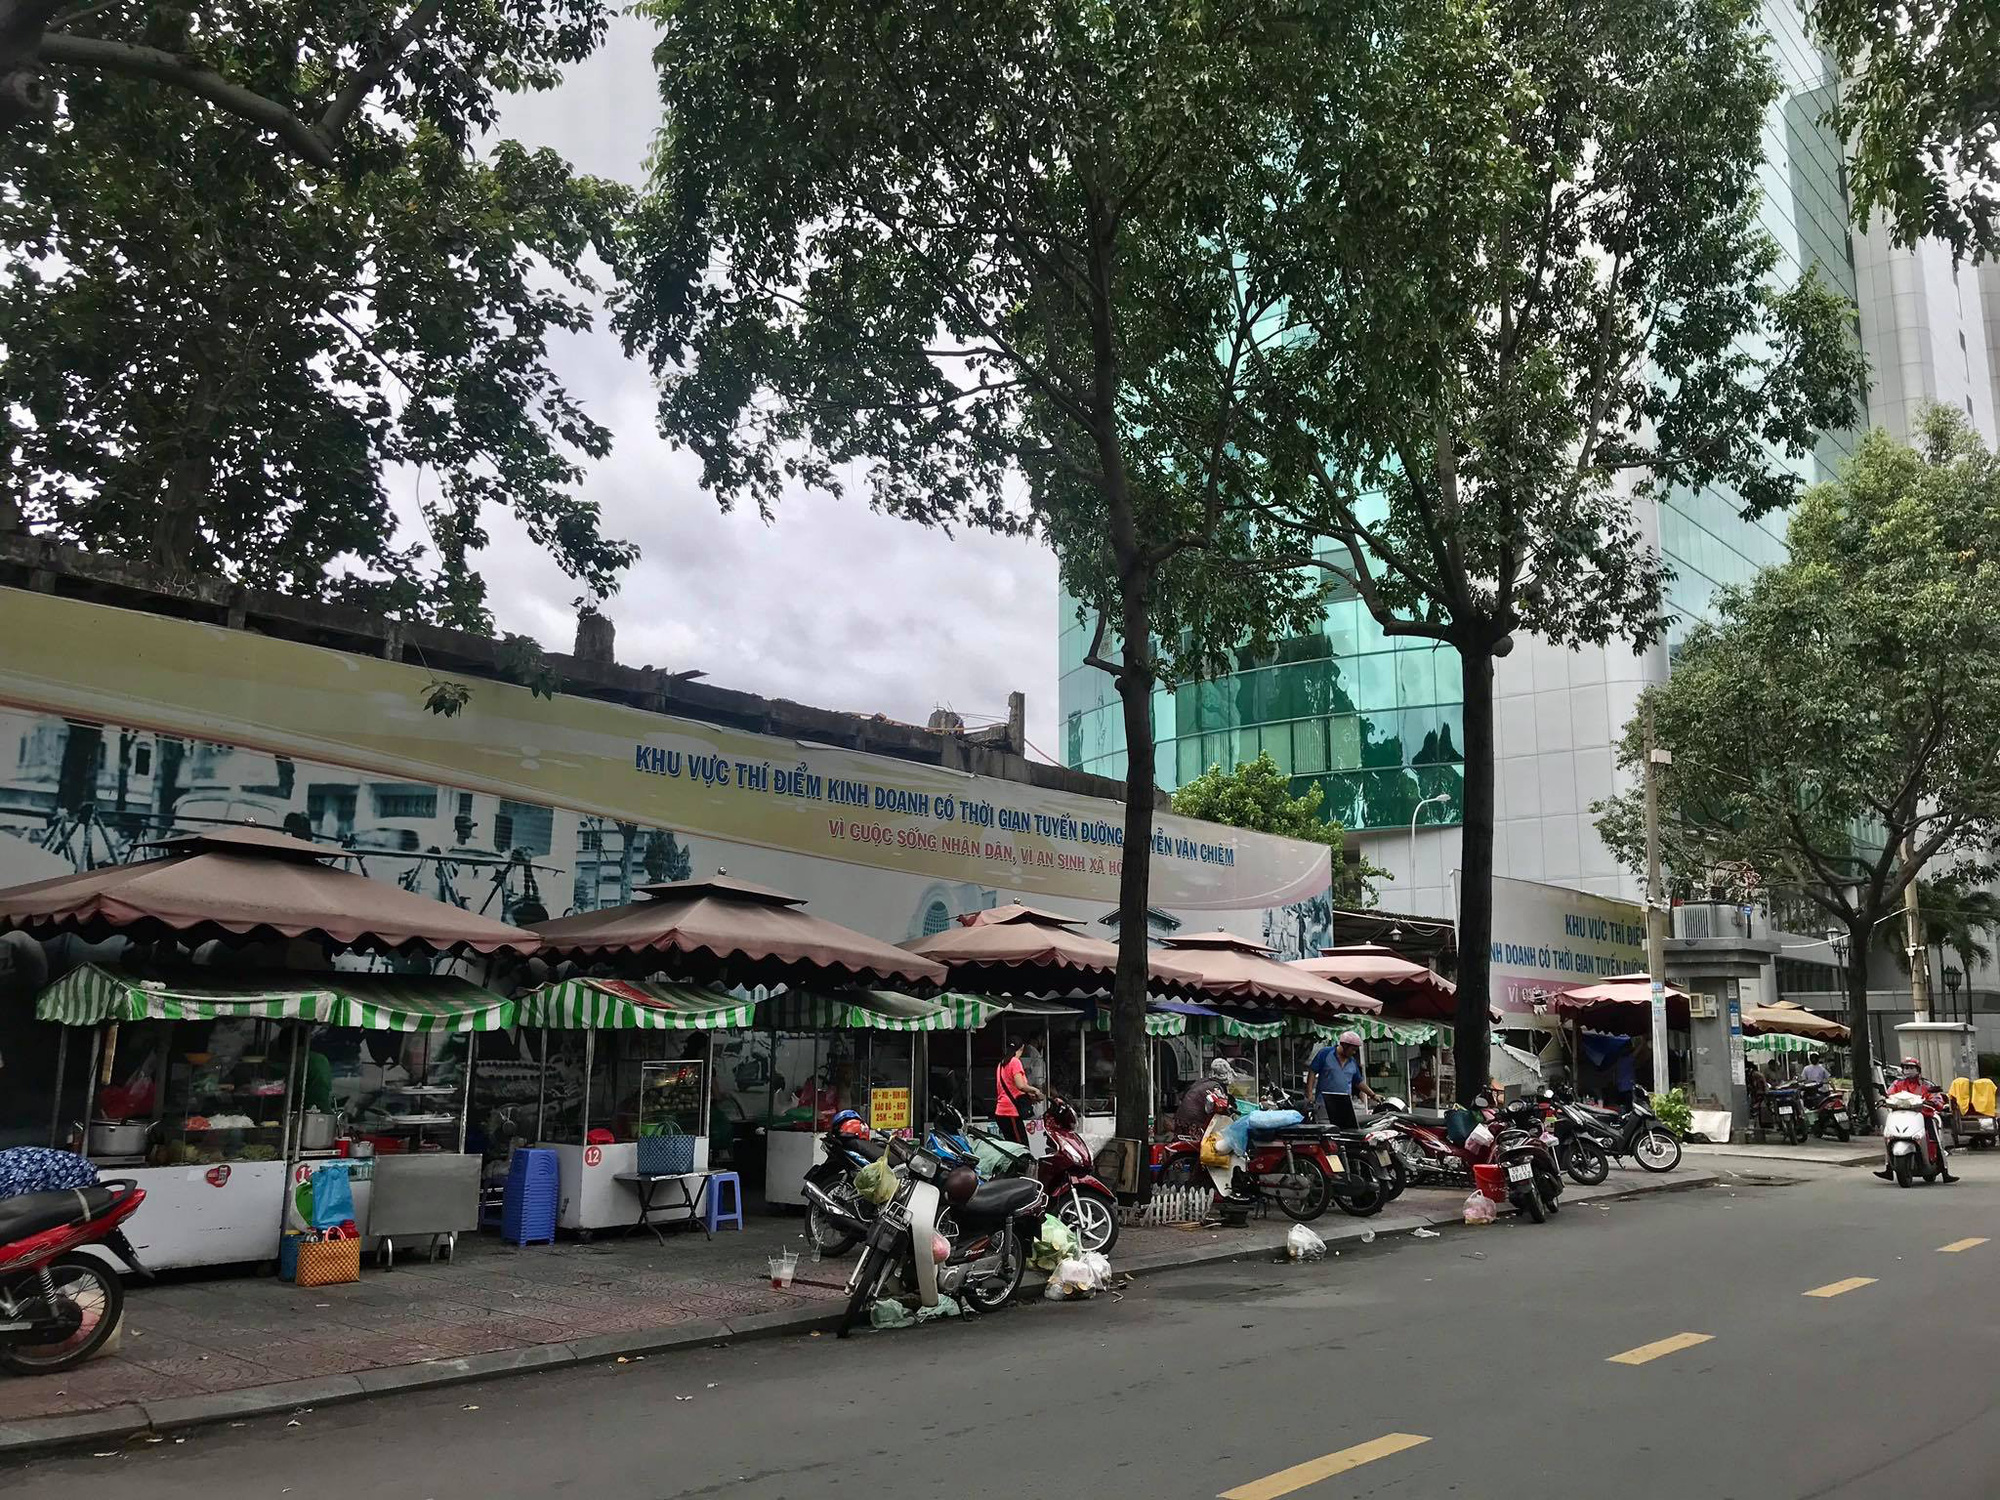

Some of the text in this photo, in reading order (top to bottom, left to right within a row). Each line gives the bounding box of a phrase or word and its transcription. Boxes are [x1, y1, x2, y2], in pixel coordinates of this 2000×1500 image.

[635, 745, 1235, 866] KHU VỰC THÍ ĐIỂM KINH DOANH CÓ THỜI GIAN TUYẾN ĐƯỜNG YỄN VĂN CHIÊM
[828, 817, 1124, 878] VÌ CUỘC SỐNG NHÂN DÂN, VÌ AN SINH XÃ HỘ
[1565, 913, 1586, 938] KHU
[1588, 916, 1607, 944] VỰC
[1609, 919, 1625, 945] THÍ
[1505, 943, 1536, 967] DOANH
[1538, 943, 1551, 968] CÓ
[1552, 946, 1573, 971] THỜI
[1575, 952, 1594, 974] GIAN
[1596, 951, 1621, 977] TUYẾN
[1507, 983, 1519, 1003] VÌ
[587, 1149, 600, 1163] 12
